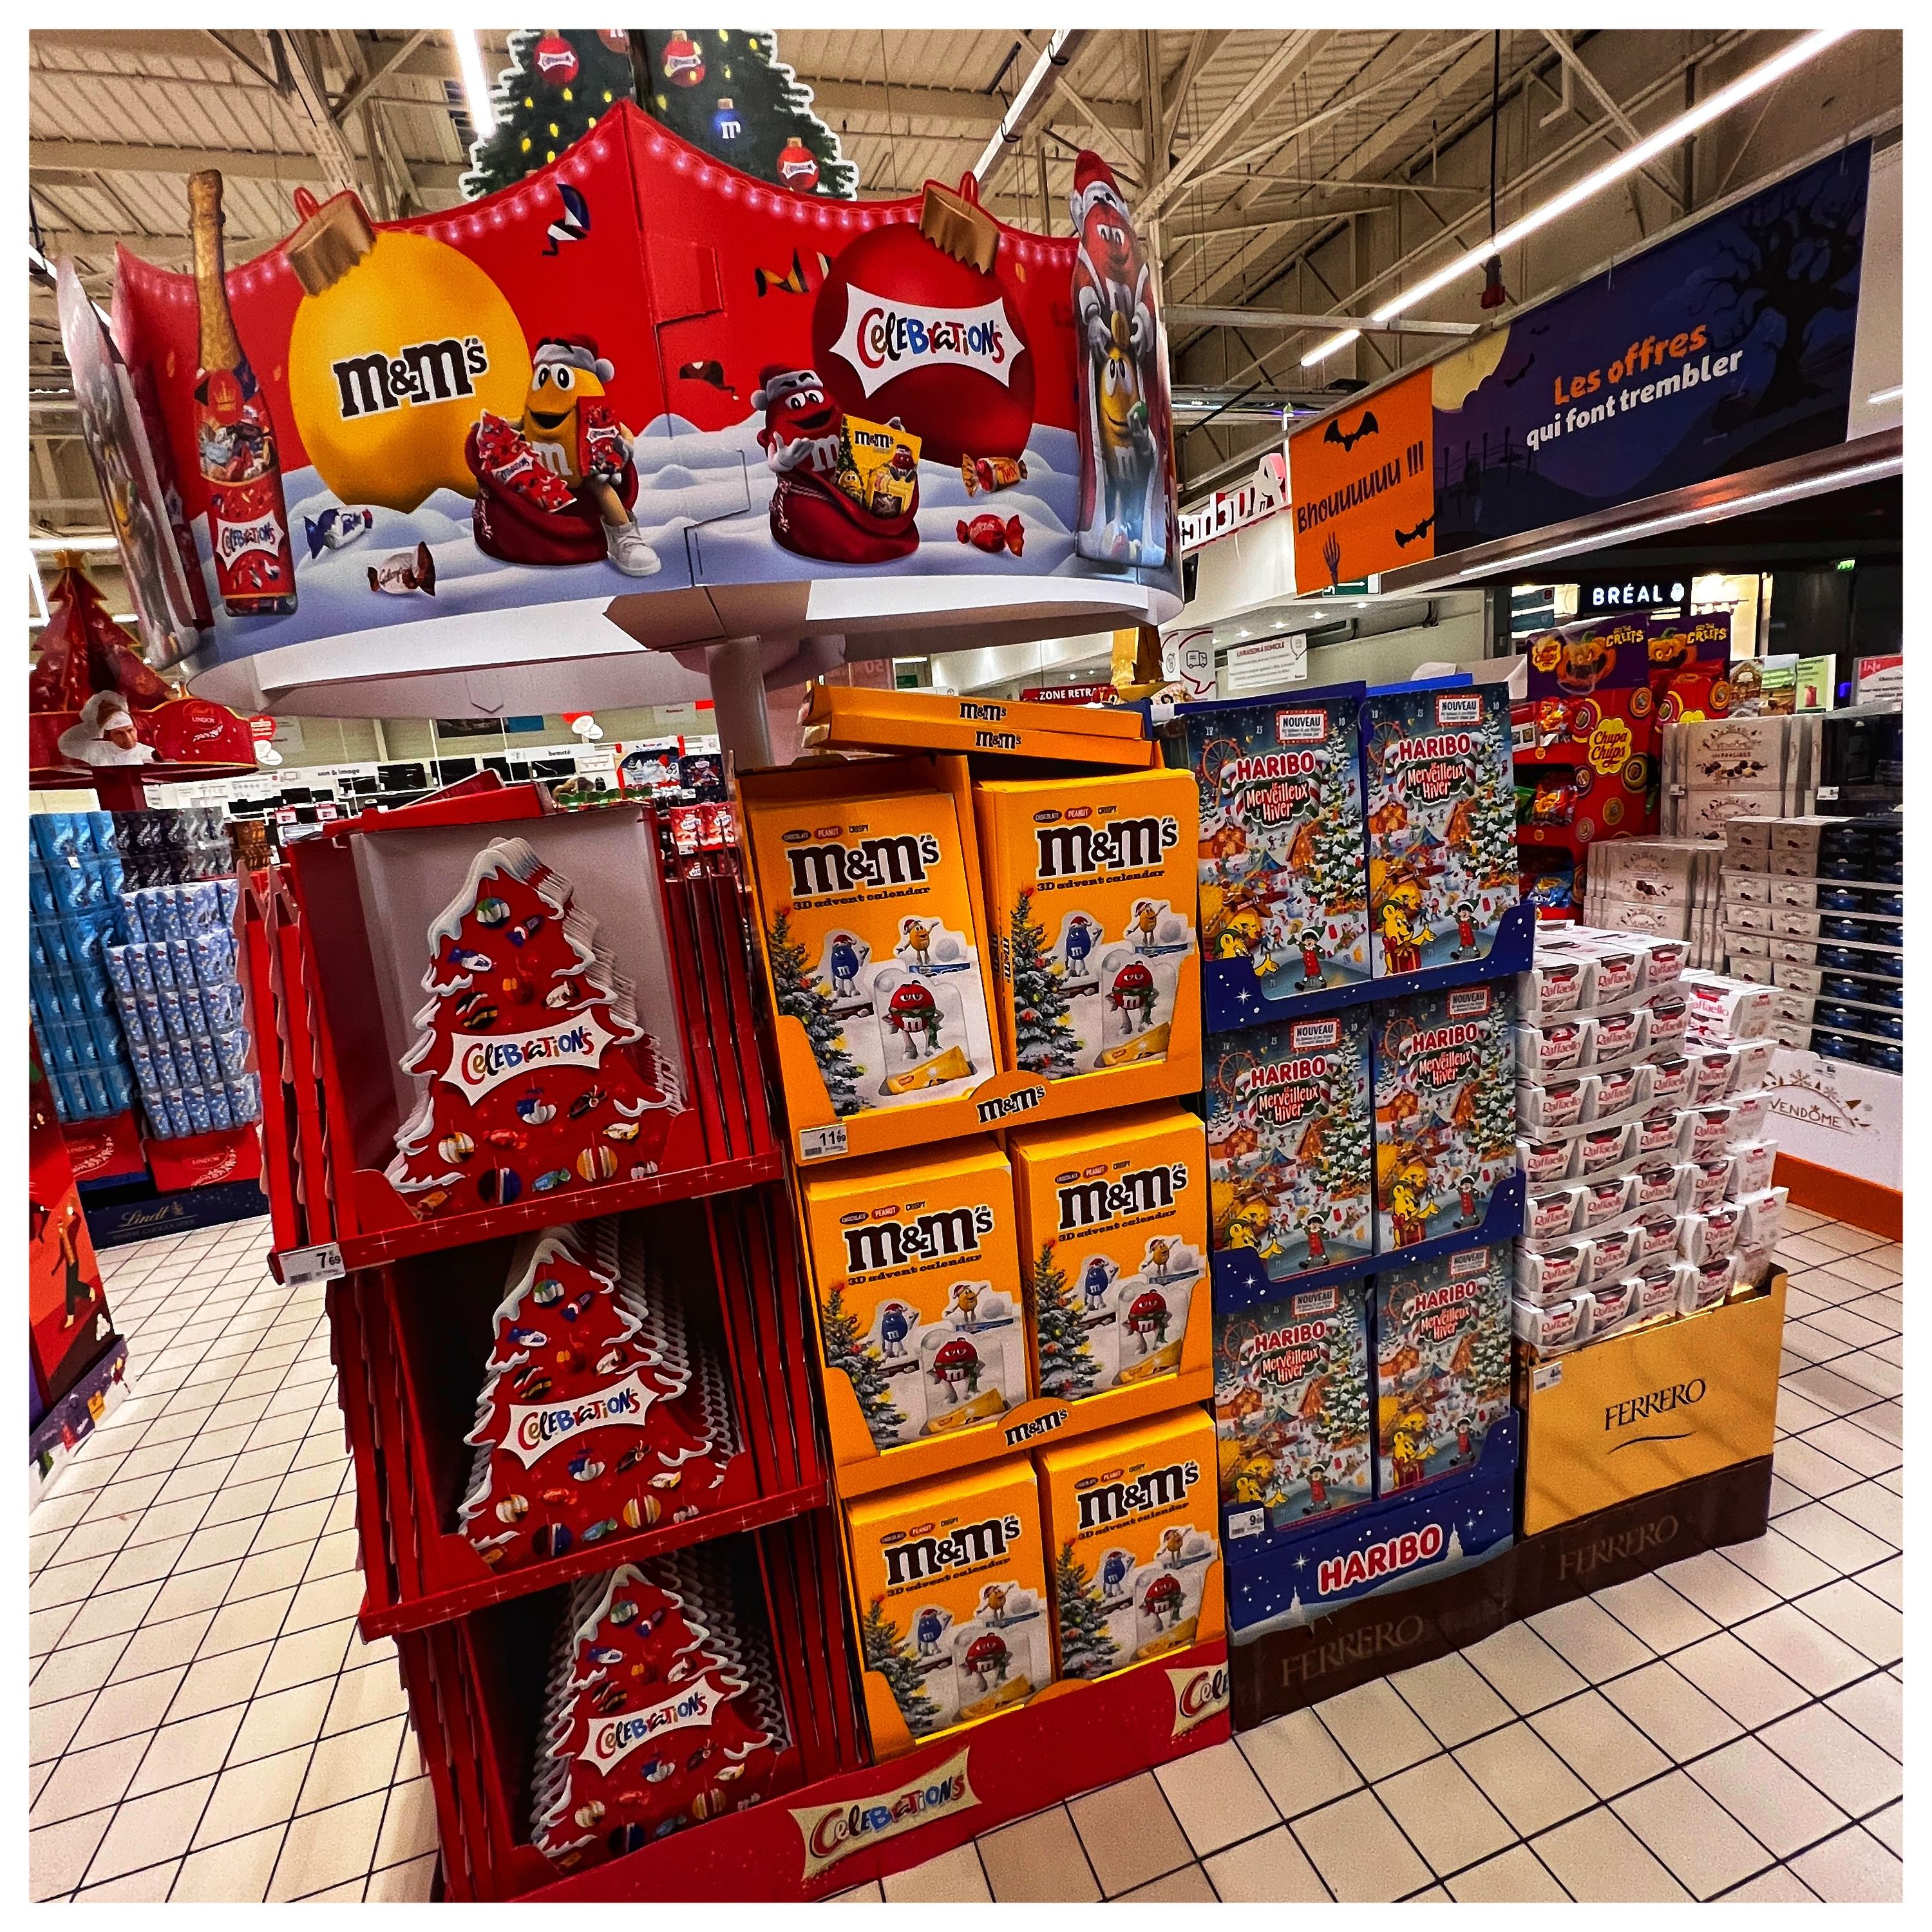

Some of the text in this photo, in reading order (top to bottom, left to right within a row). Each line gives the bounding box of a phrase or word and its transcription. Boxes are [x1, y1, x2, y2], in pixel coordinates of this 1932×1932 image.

[1554, 324, 1707, 406] Les offres
[1526, 349, 1743, 451] qui font trembler
[1593, 584, 1663, 606] BRÉAL
[1039, 690, 1066, 701] ZONE
[1441, 699, 1477, 712] NOUVEAU
[1282, 715, 1321, 728] NOUVEAU
[1399, 734, 1472, 762] HARIBO
[1594, 730, 1628, 746] Chupa
[1591, 744, 1625, 764] Chups
[1236, 751, 1315, 782] HARIBO
[1407, 762, 1464, 788] Merveilleux
[1245, 782, 1309, 809] Merveilleux
[1422, 781, 1452, 799] Hiver
[1035, 812, 1060, 821] CHOCOLATE
[1067, 808, 1089, 819] PEANUT
[1262, 802, 1294, 822] Hiver
[817, 828, 840, 838] PEANUT
[1036, 869, 1165, 891] 3D advent calendar
[793, 886, 931, 911] 3D advent calendar
[1540, 983, 1578, 998] Raffaello
[1692, 999, 1729, 1017] affaello
[1296, 1023, 1334, 1037] NOUVEAU
[1412, 1023, 1479, 1054] HARIBO
[1540, 1041, 1580, 1057] Raffaello
[1251, 1056, 1327, 1088] HARIBO
[1258, 1084, 1319, 1112] Merveilleux
[1274, 1103, 1304, 1122] Hiver
[1085, 1166, 1105, 1177] PEANUT
[122, 1205, 170, 1227] Lindt
[875, 1207, 896, 1217] PEANUT
[905, 1201, 926, 1211] CRISPY
[1058, 1210, 1177, 1242] 3D advent calendar
[848, 1255, 982, 1286] 3D advent calendar
[1297, 1290, 1332, 1305] NOUVEAU
[1415, 1280, 1477, 1312] HARIBO
[1255, 1321, 1326, 1353] HARIBO
[1262, 1346, 1319, 1374] Merveilleux
[1277, 1363, 1305, 1383] Hiver
[1604, 1378, 1707, 1431] FERRERO
[912, 1524, 932, 1535] PEANUT
[1095, 1517, 1136, 1535] advent
[1137, 1502, 1189, 1521] calendar
[1560, 1515, 1679, 1580] FERRERO
[1319, 1525, 1442, 1594] HARIBO
[887, 1557, 1010, 1597] 3D advent calendar
[1282, 1615, 1425, 1687] FERRERO
